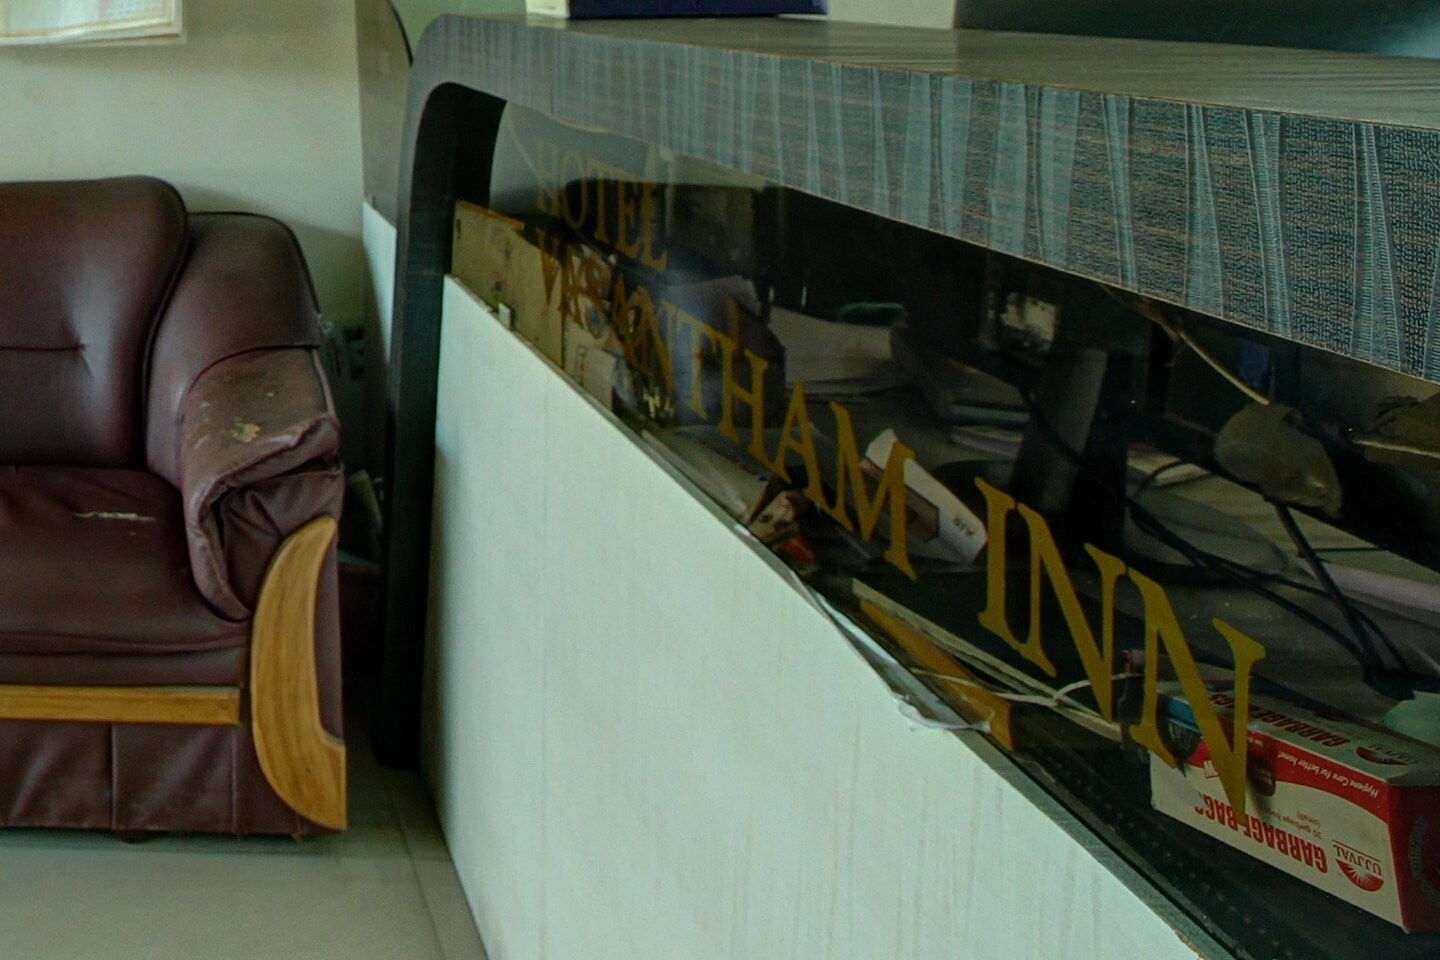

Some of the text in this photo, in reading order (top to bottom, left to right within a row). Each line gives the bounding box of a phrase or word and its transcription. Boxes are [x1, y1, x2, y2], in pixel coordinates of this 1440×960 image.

[536, 142, 668, 273] HOTEL
[536, 226, 1266, 826] VASANTHAM INN
[1297, 759, 1320, 775] better
[1320, 768, 1332, 779] for
[1333, 774, 1349, 786] Care
[1348, 780, 1379, 799] Hygiene
[1242, 816, 1329, 874] GARBAGE
[1333, 843, 1383, 876] UJJVAL
